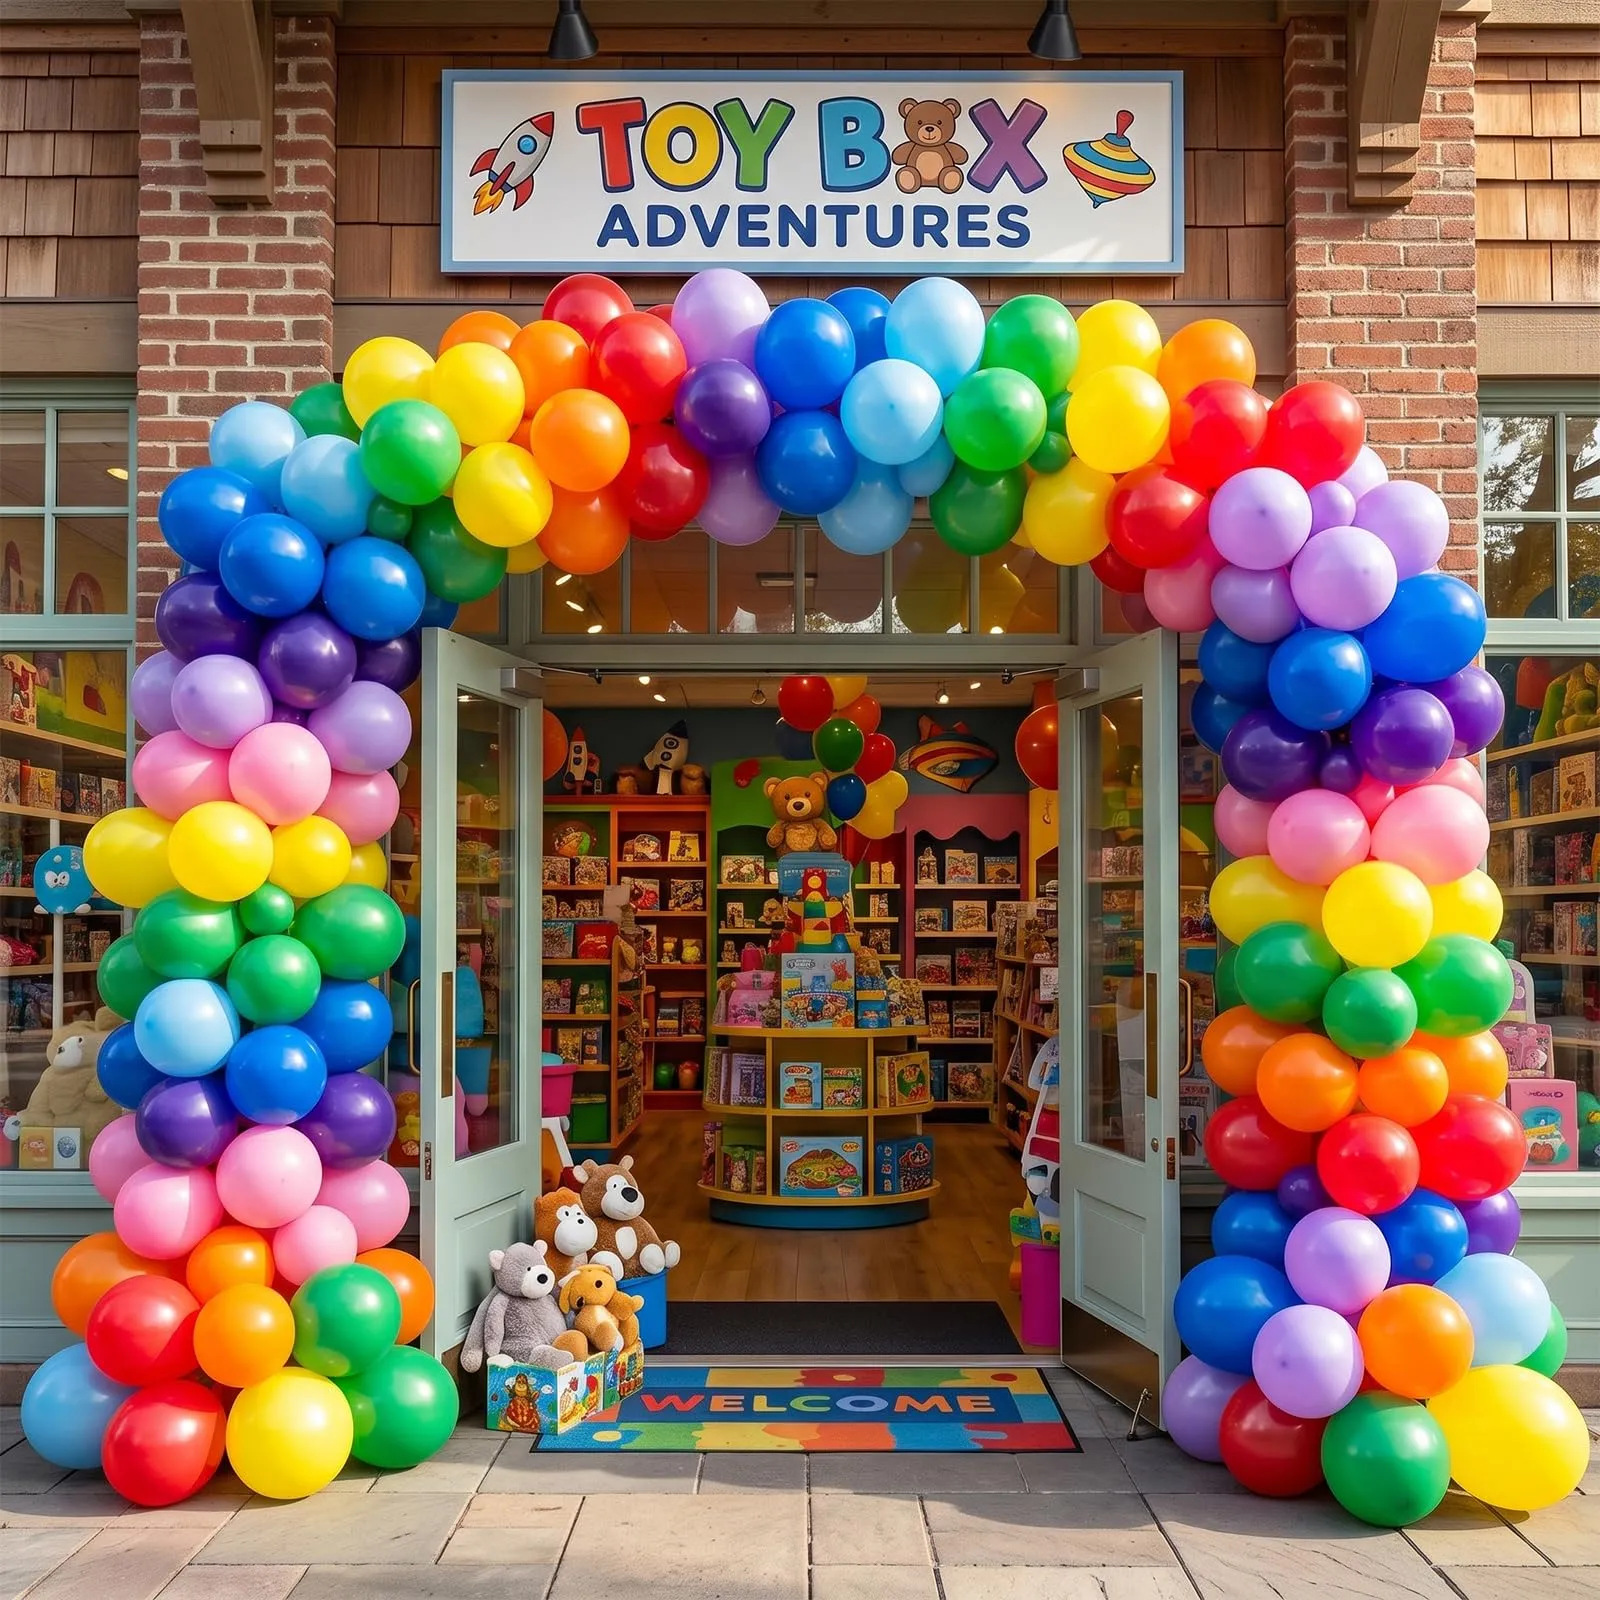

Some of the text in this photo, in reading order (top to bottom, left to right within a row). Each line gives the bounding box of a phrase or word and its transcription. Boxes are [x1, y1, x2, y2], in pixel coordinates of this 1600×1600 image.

[576, 96, 1049, 194] TOY BX
[597, 203, 1031, 248] ADVENTURES
[641, 1394, 996, 1412] WELCOME
